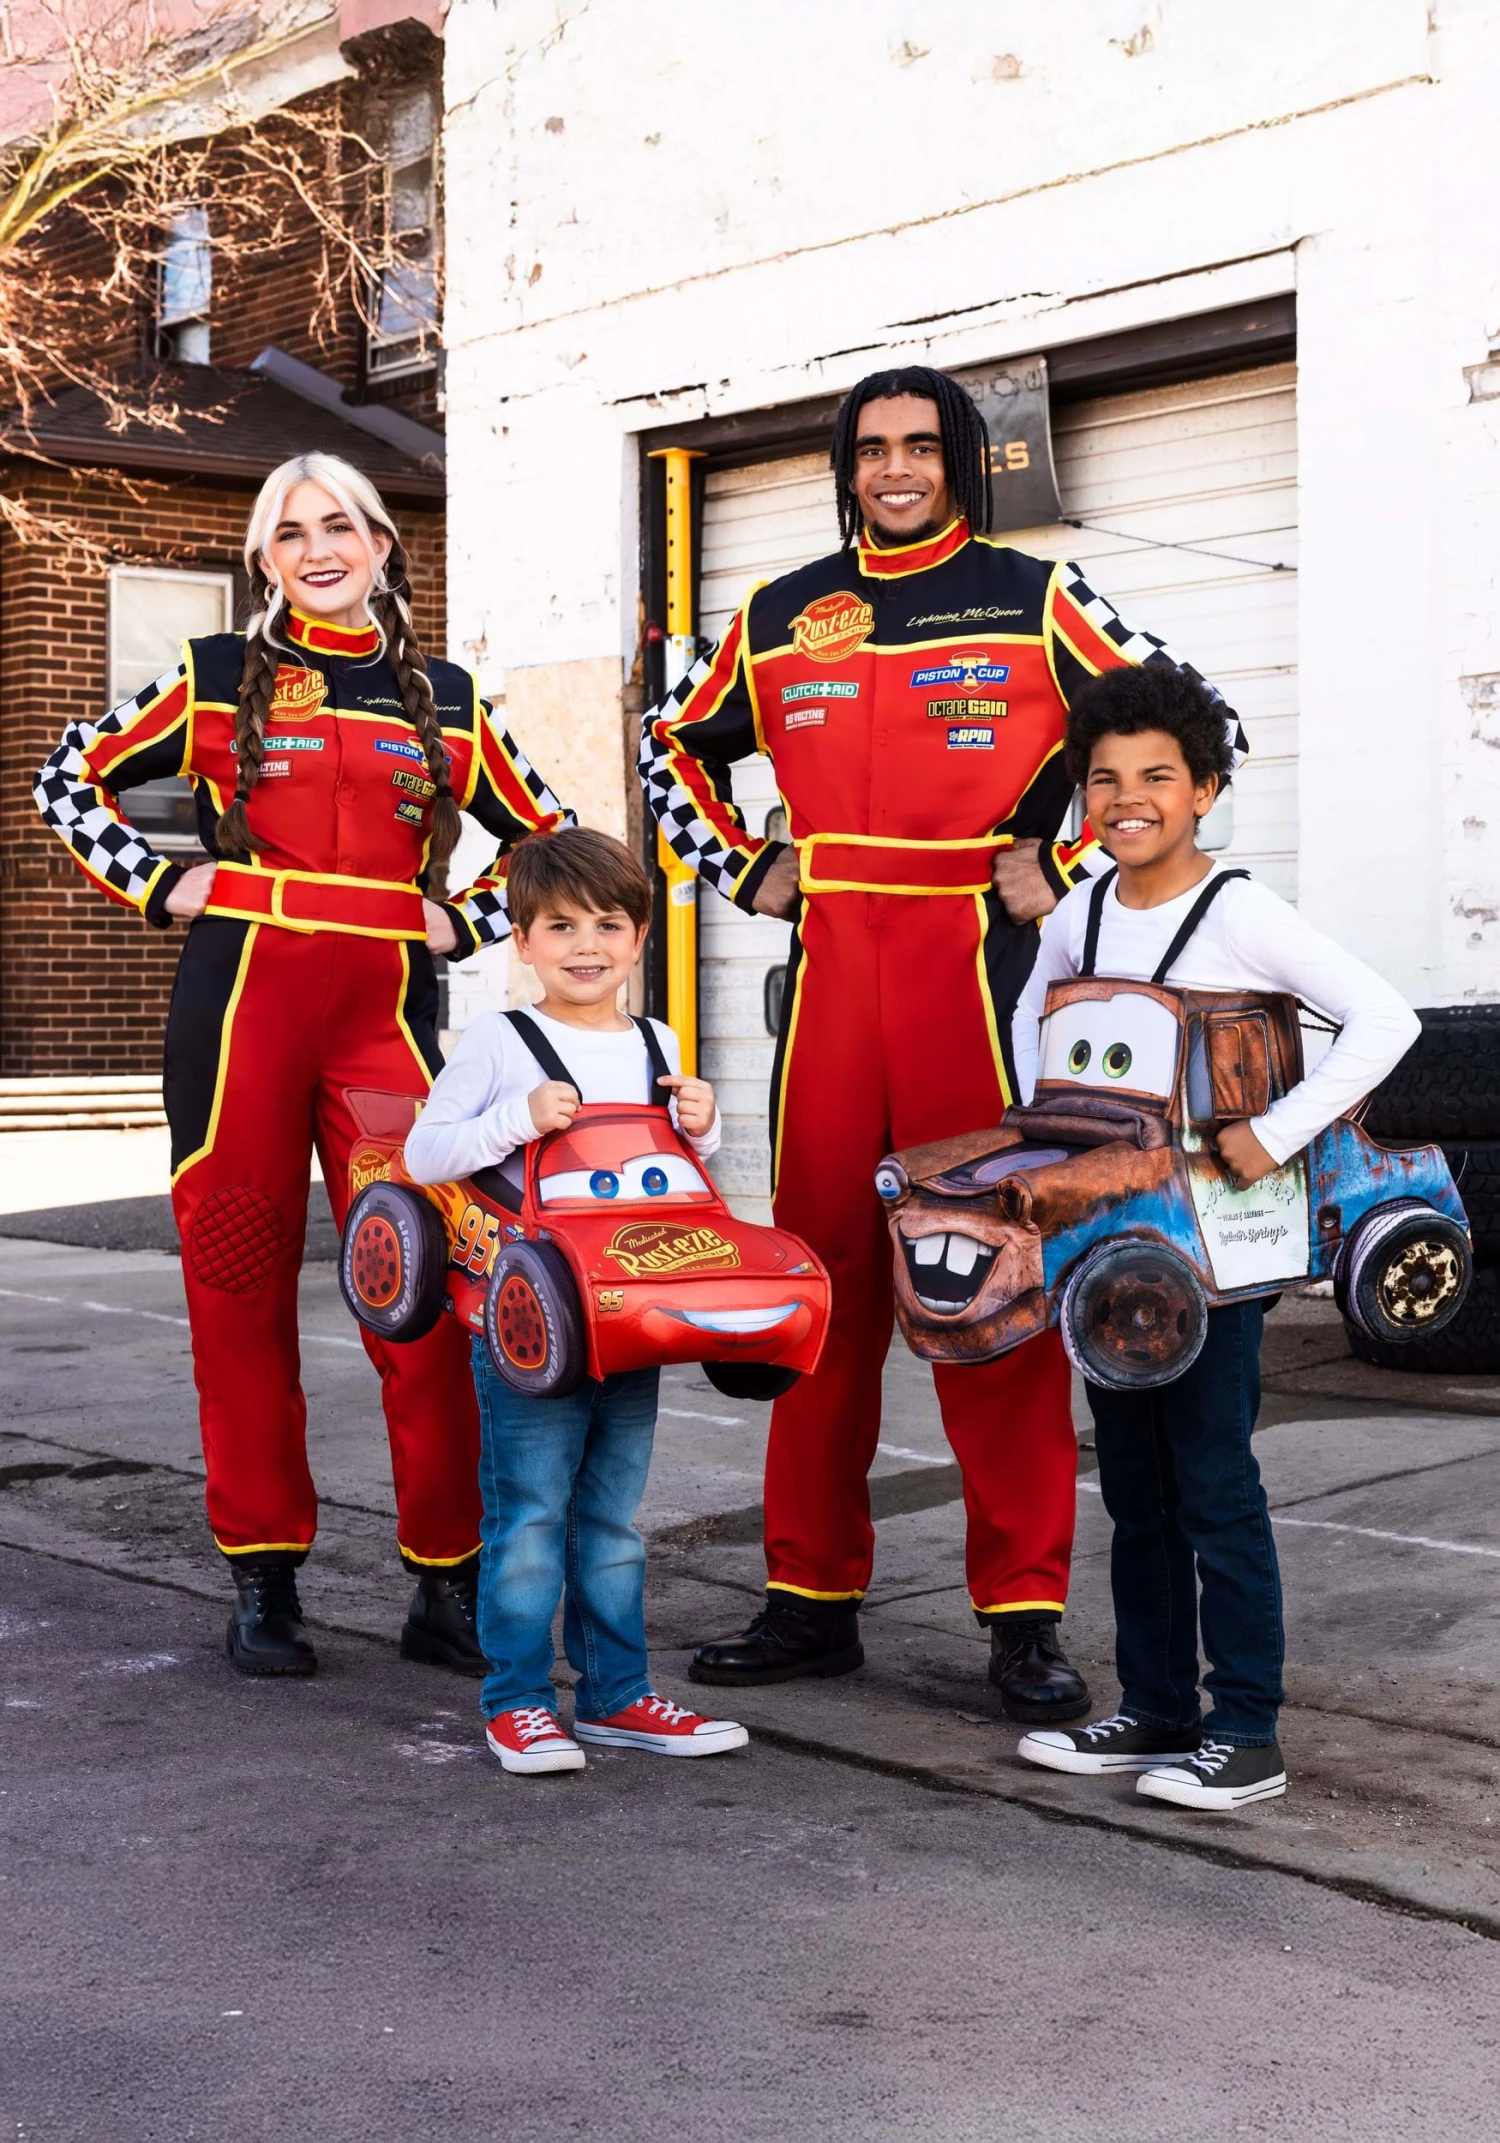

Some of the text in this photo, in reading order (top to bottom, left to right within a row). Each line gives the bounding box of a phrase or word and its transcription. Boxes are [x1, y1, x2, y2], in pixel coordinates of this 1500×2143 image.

[906, 607, 1024, 627] Lightning McQueen
[916, 667, 1005, 683] PISTON CUP
[380, 742, 419, 758] PISTON
[451, 1203, 500, 1276] 95
[623, 1227, 668, 1250] Medicated
[345, 1201, 370, 1304] LIGHTYEAR
[388, 1218, 412, 1322] LIGHTYEAR
[598, 1289, 624, 1312] 95
[533, 1281, 560, 1384] LIGHTYEAR
